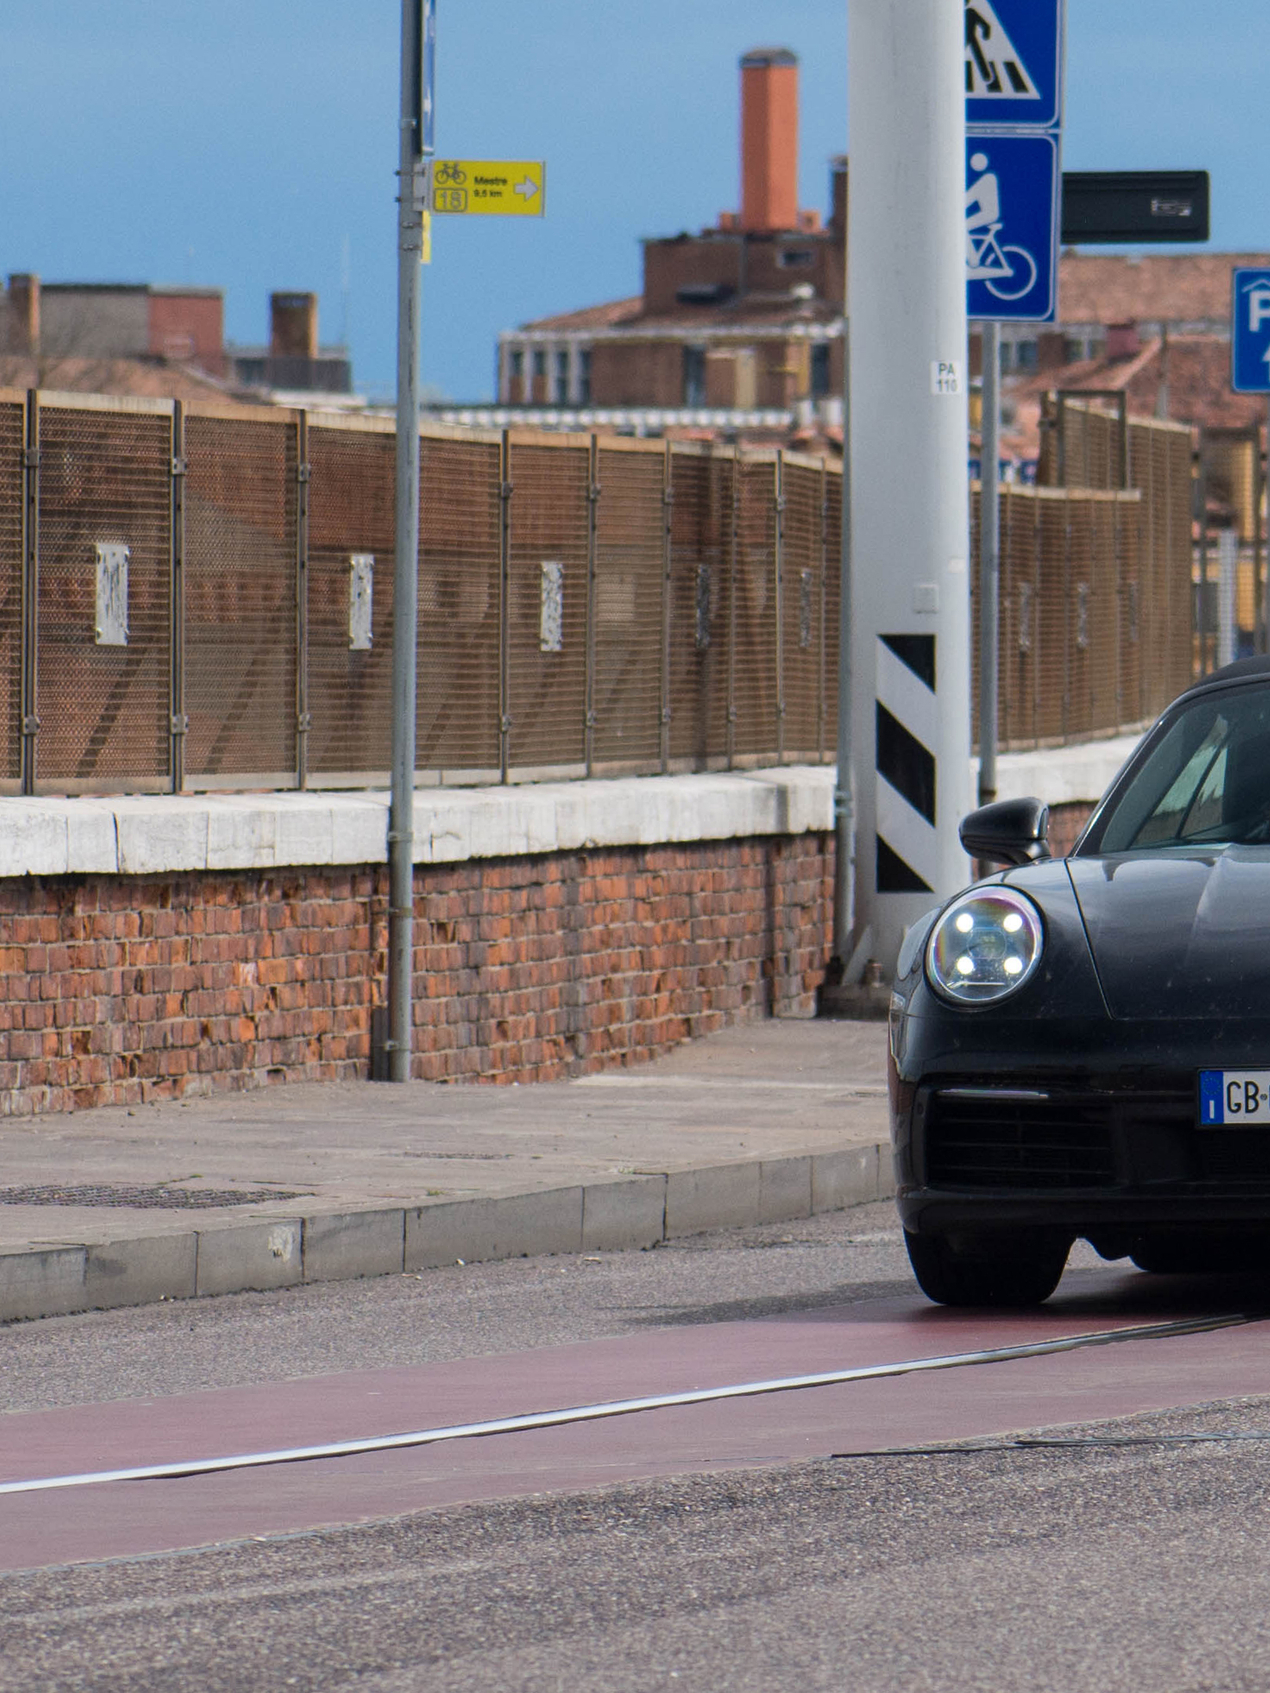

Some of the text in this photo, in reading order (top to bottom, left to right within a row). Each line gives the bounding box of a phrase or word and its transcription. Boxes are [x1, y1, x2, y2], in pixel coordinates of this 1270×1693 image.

[474, 176, 508, 186] Mestre
[490, 190, 502, 198] km
[440, 191, 463, 209] 18
[938, 362, 955, 375] PA
